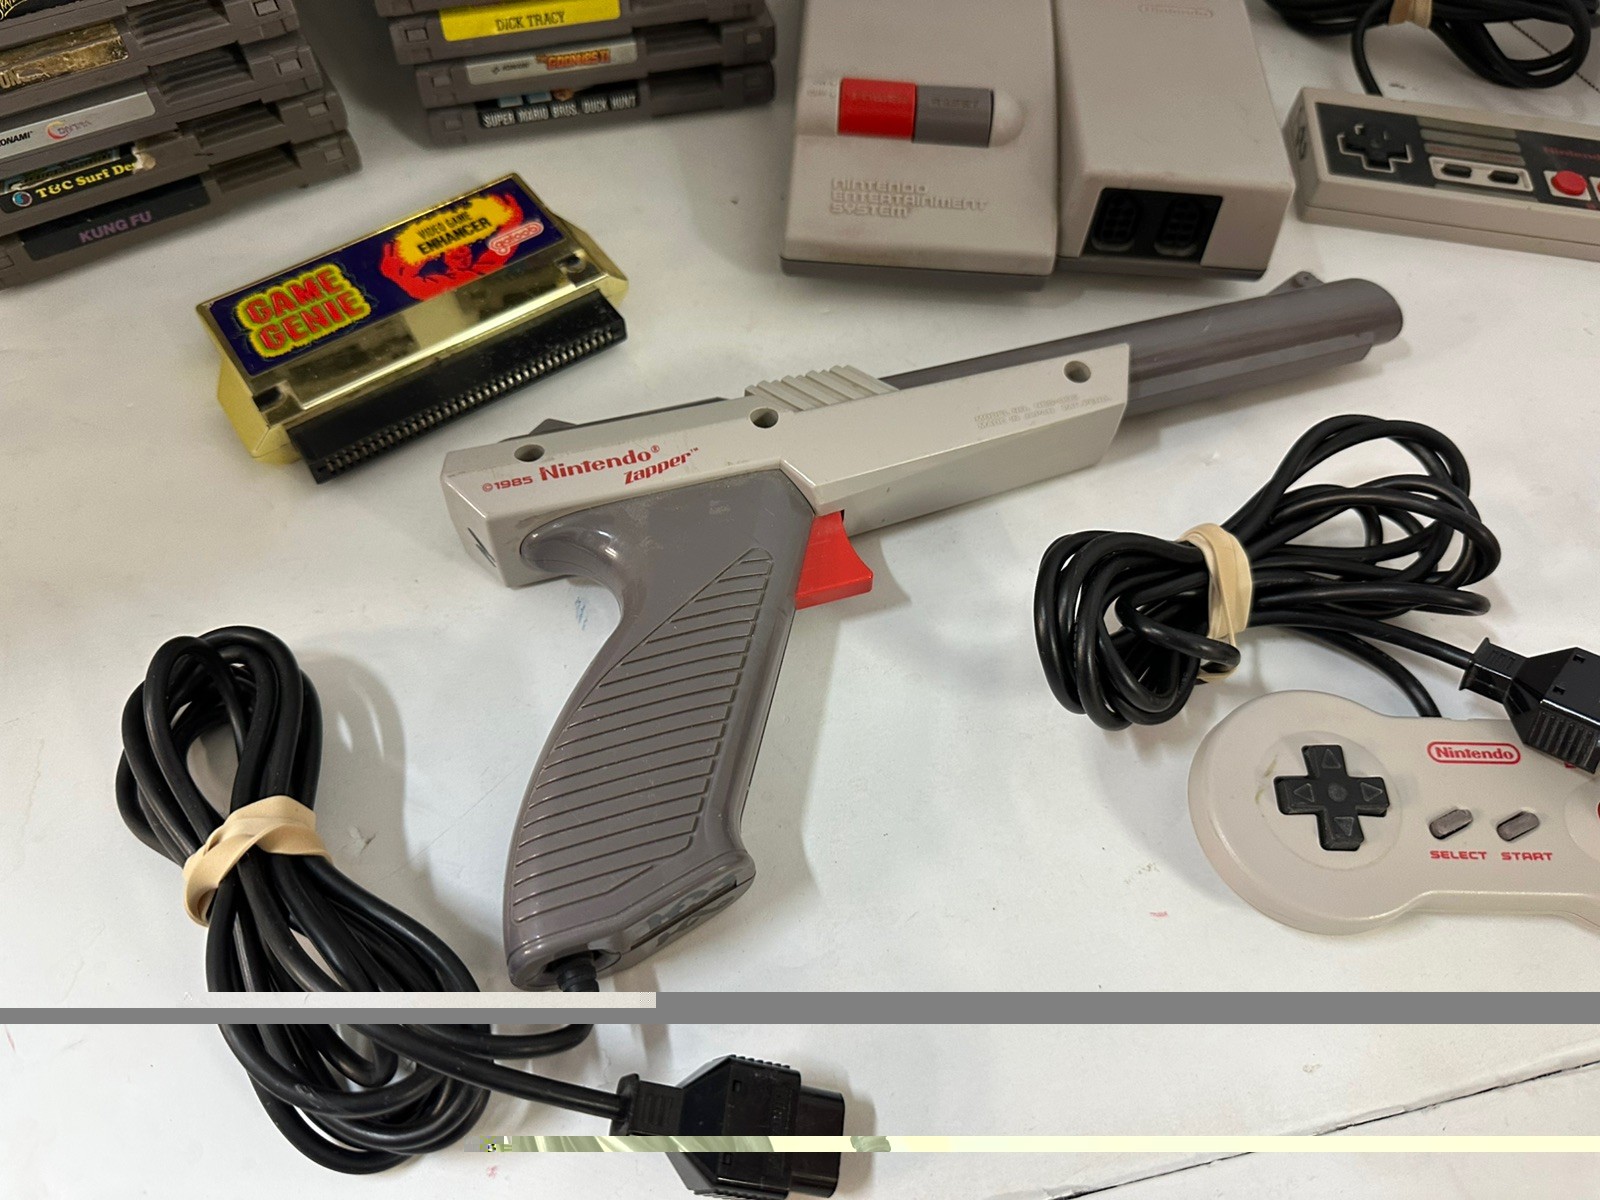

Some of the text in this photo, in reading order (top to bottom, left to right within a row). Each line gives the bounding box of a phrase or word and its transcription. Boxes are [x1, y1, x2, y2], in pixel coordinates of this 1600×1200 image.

[495, 11, 565, 32] DICK TRACY
[482, 110, 516, 128] SUPER
[517, 106, 549, 123] MARIO
[582, 98, 608, 114] DUCK
[610, 92, 637, 110] HUNT
[35, 181, 74, 198] T&C
[76, 169, 110, 186] Surf
[831, 178, 927, 194] NINTENDO
[829, 202, 909, 218] SYSTEM
[831, 190, 985, 210] ENTERTAINMENT
[79, 211, 152, 243] KUNG FU
[417, 222, 446, 240] VIDEO
[417, 217, 492, 255] ENHANCER
[246, 268, 345, 325] GAME
[259, 293, 364, 351] GENIE
[1434, 746, 1514, 760] Nintendo
[1430, 850, 1553, 861] SELECT START
